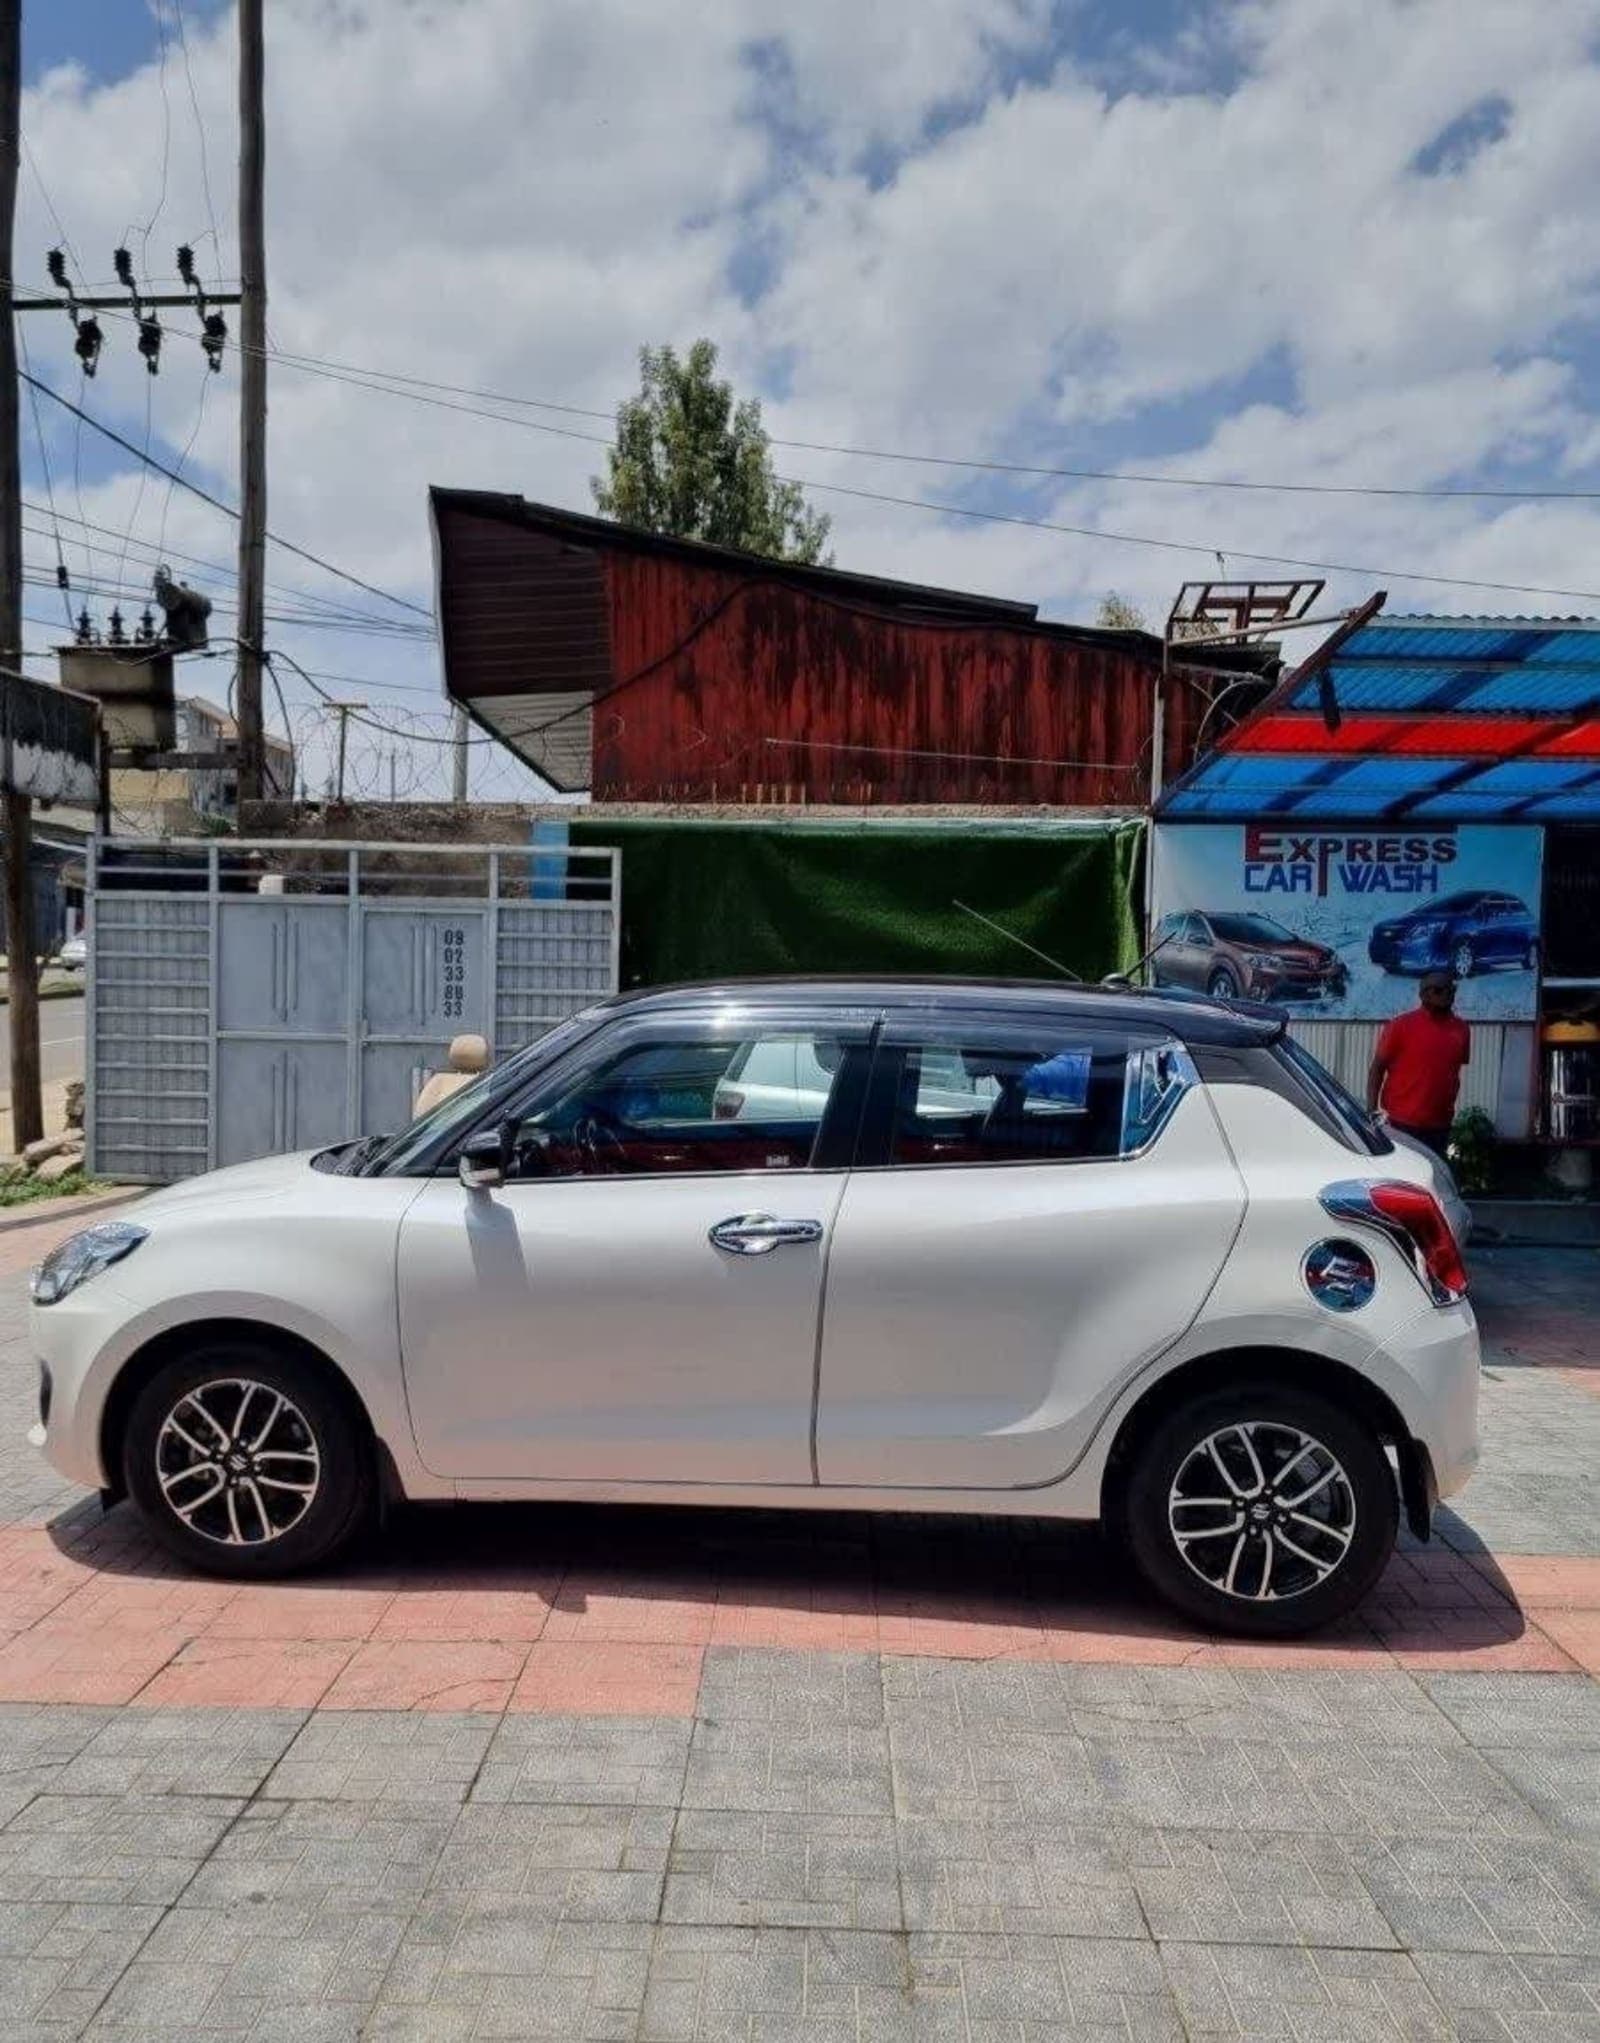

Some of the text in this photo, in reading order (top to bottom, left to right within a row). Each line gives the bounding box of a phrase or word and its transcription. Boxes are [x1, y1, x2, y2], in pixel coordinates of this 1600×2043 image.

[1245, 825, 1458, 864] EXPRESS
[1244, 863, 1438, 893] CAR WASH
[443, 1001, 462, 1017] 33
